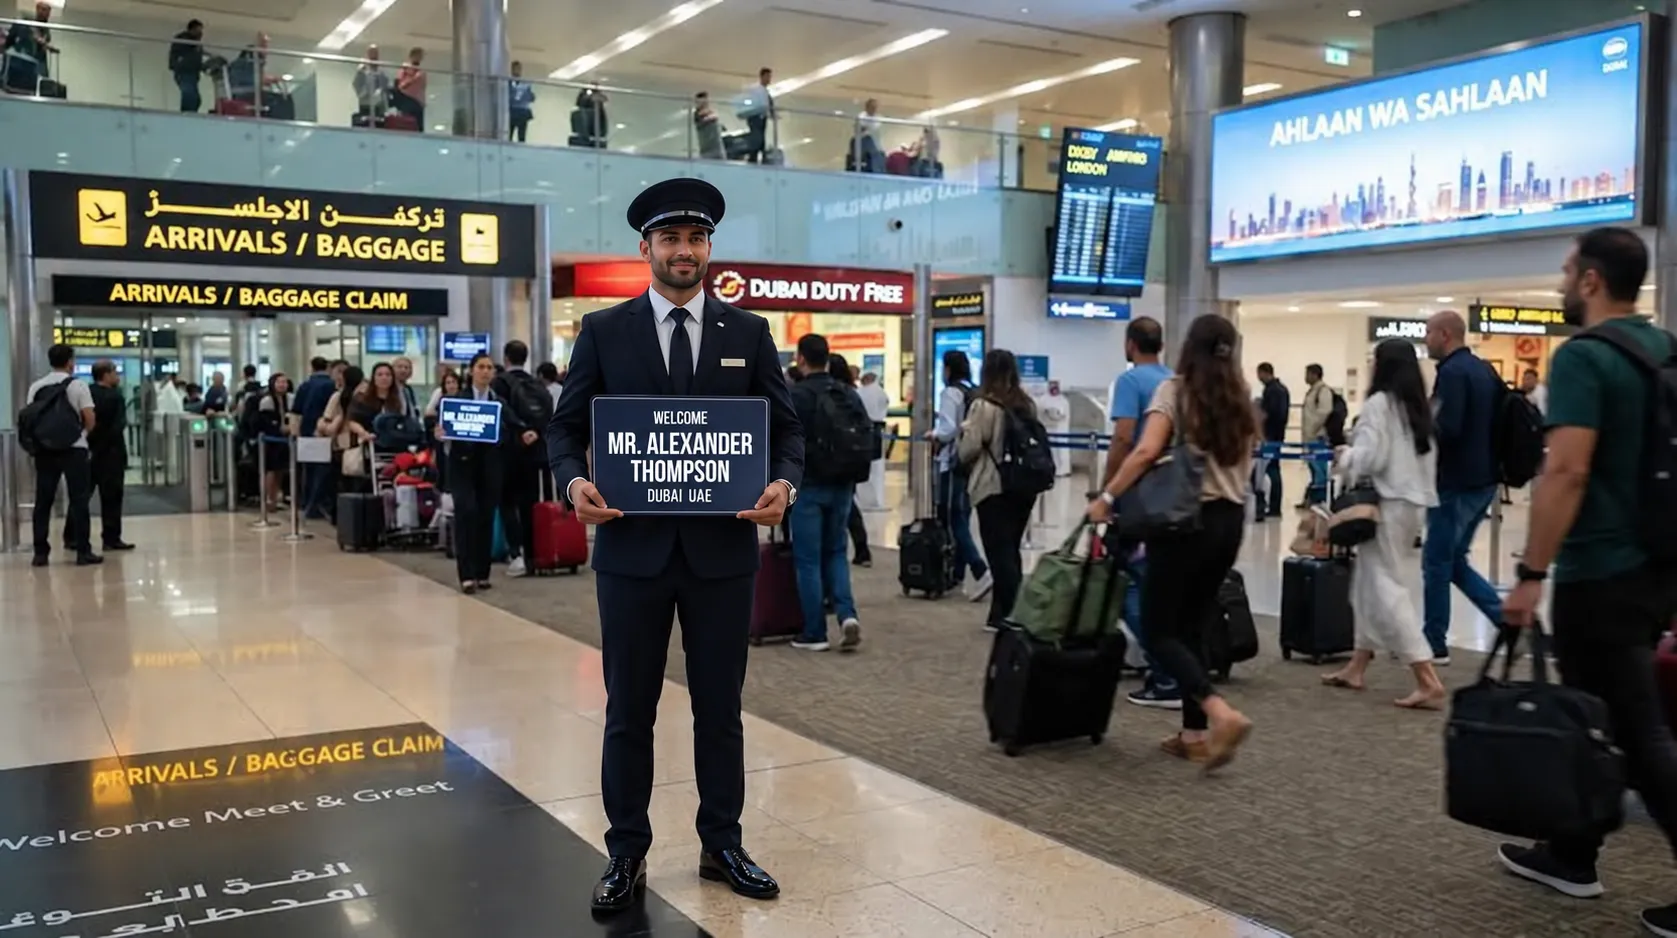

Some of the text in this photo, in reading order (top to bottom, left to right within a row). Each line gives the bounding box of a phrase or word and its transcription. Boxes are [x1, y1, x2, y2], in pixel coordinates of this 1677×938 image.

[1269, 69, 1548, 147] AHLAAN WA SAHLAAN
[1066, 160, 1108, 176] LONDON
[144, 225, 446, 263] ARRIVALS / BAGGAGE
[109, 283, 408, 310] ARRIVALS / BAGGAGE CLAIM
[750, 278, 904, 304] DUBAI DUTY FREE
[653, 411, 708, 425] WELCOME
[608, 432, 753, 455] MR. ALEXANDER
[630, 459, 730, 483] THOMPSON
[647, 488, 712, 503] DUBAI UAE
[92, 735, 444, 788] ARRIVALS / BAGGAGE CLAIM
[204, 799, 308, 824] Meet
[316, 795, 346, 808] &
[353, 780, 454, 802] Greet
